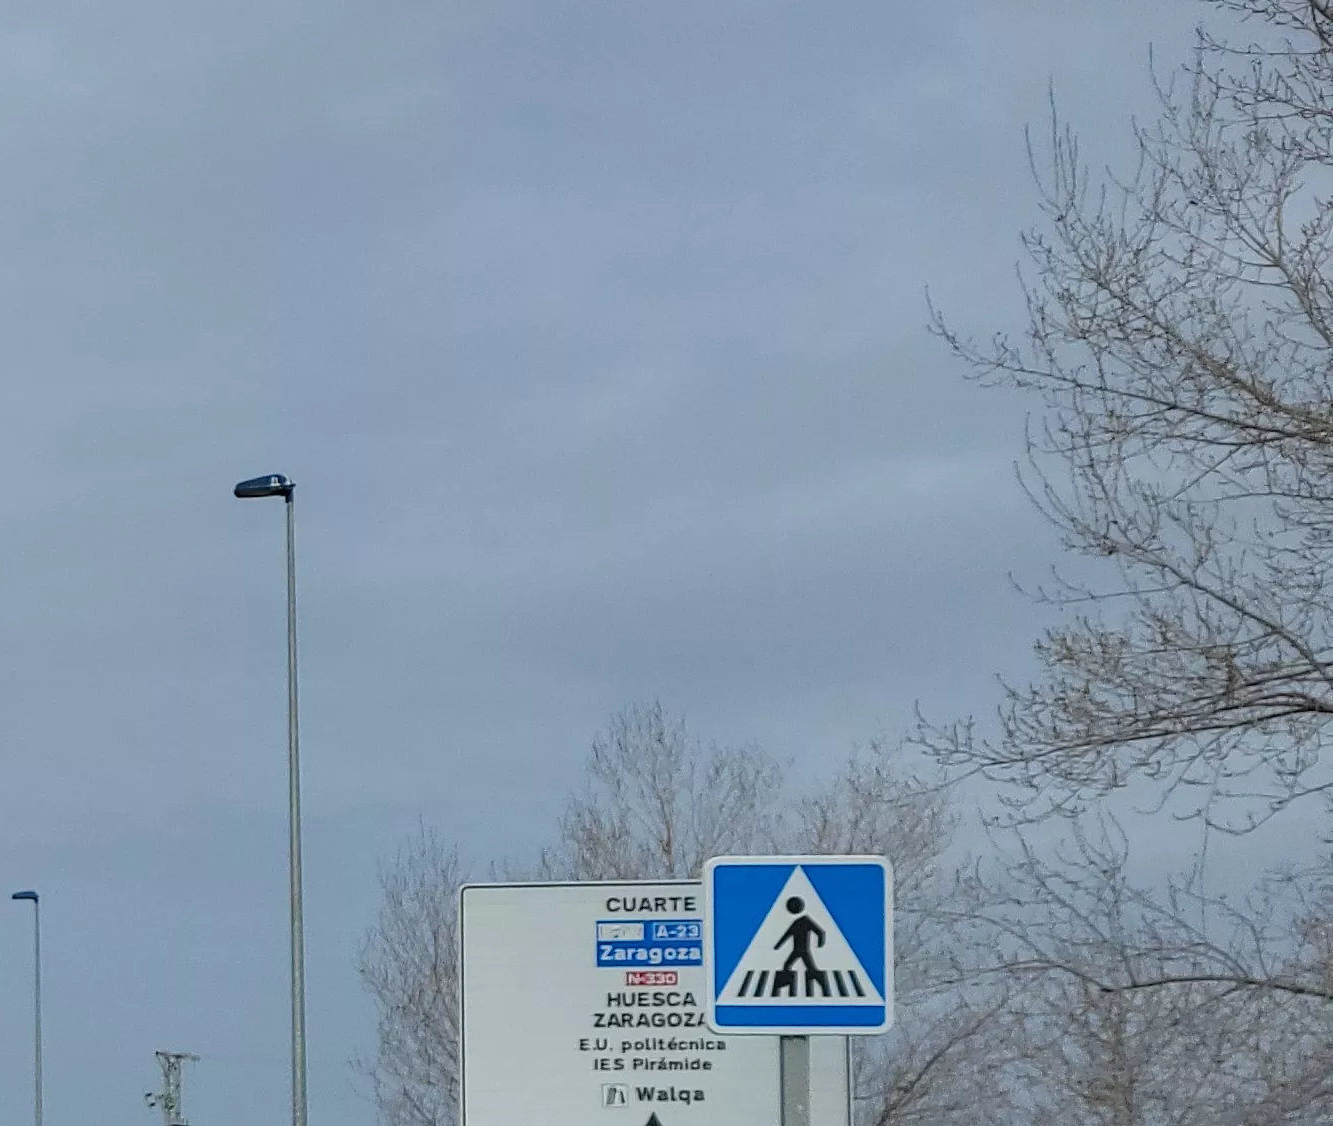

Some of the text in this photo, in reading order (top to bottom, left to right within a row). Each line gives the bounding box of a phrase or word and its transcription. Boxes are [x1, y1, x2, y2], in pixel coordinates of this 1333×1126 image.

[606, 896, 696, 912] CUARTE
[656, 925, 699, 938] A-23
[599, 944, 701, 964] Zaragoza
[628, 972, 676, 984] N-330
[607, 991, 697, 1007] HUESCA
[579, 1037, 727, 1053] E.U. politécnica
[594, 1057, 713, 1071] IES Pirámide
[636, 1086, 706, 1105] Walqa
